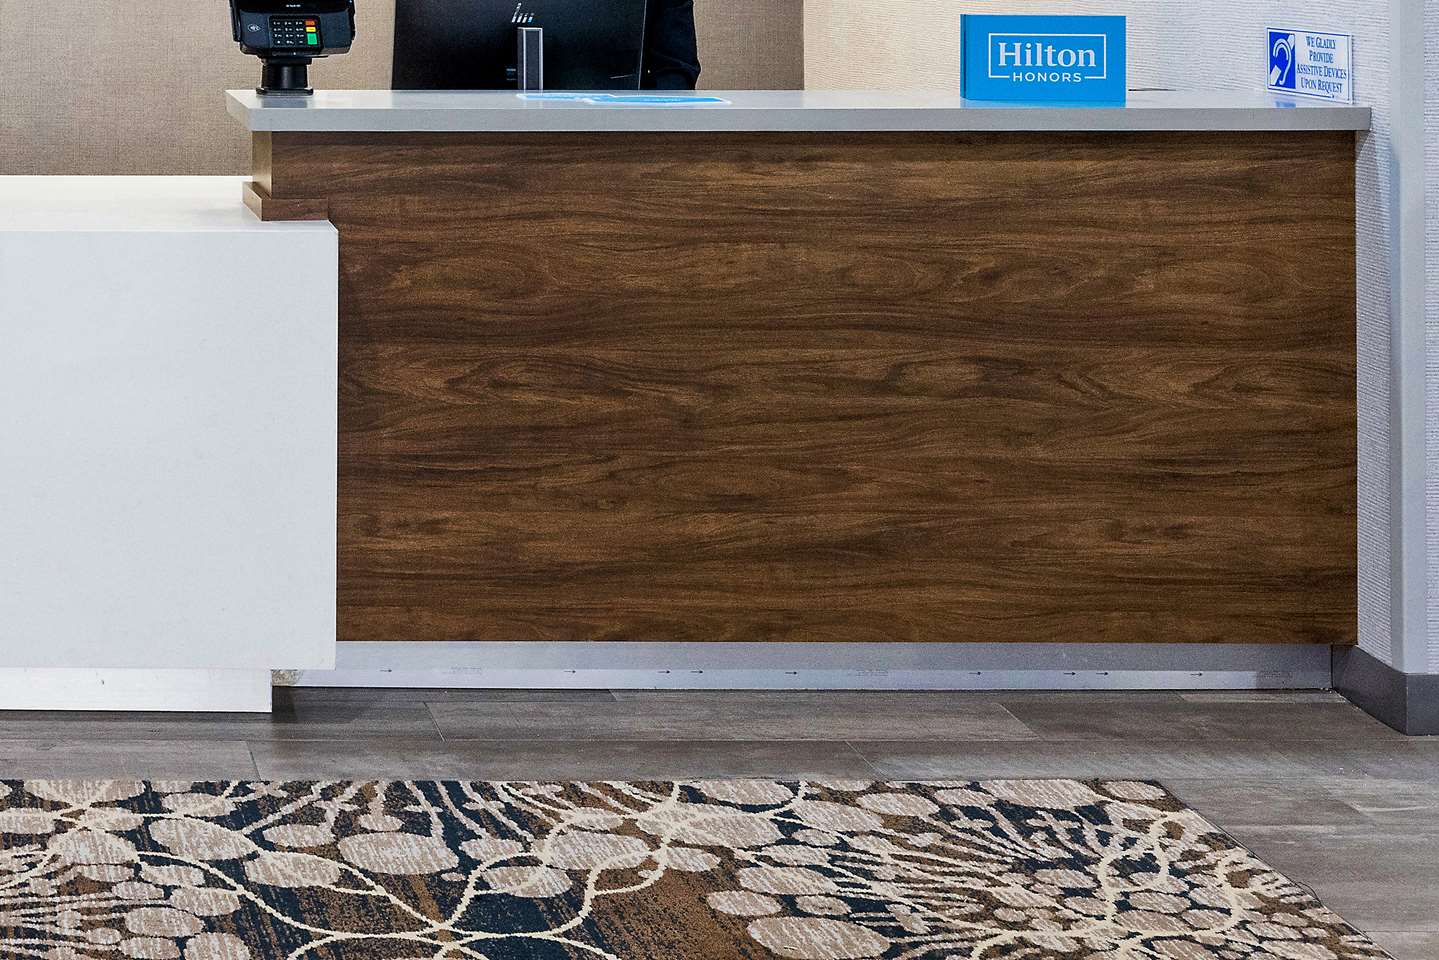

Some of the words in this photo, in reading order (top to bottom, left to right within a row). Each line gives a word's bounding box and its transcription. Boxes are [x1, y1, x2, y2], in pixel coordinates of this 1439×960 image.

[1306, 36, 1315, 48] WE
[1315, 36, 1336, 49] GLADLY
[998, 42, 1096, 67] Hilton
[1309, 50, 1334, 63] PROVIDE
[1013, 72, 1082, 82] HONORS
[1297, 63, 1322, 77] ASSISTIVE
[1324, 66, 1347, 80] DEVICES
[1301, 77, 1317, 90] UPON
[1318, 79, 1343, 94] REQUEST
